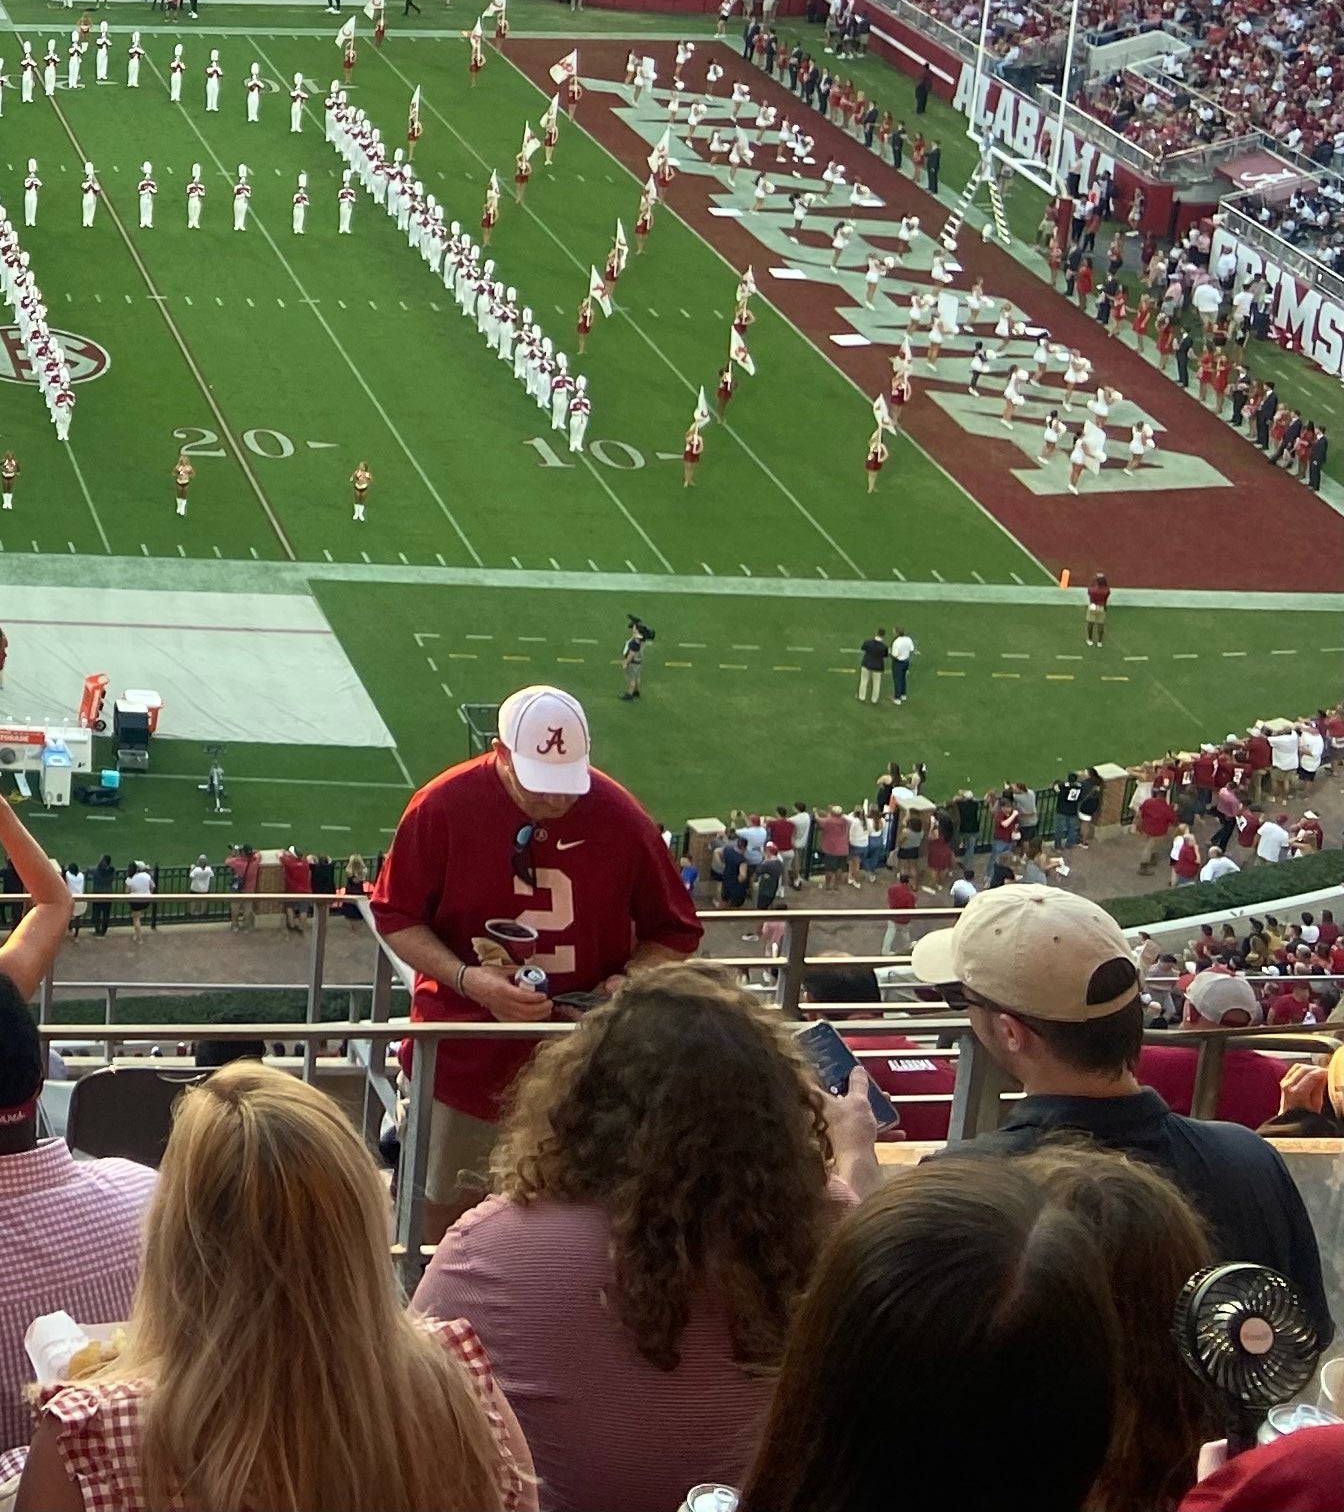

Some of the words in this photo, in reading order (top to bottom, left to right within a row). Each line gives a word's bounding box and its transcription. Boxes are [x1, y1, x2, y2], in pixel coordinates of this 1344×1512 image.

[170, 426, 297, 459] 20
[520, 436, 647, 471] 10
[536, 726, 567, 755] A
